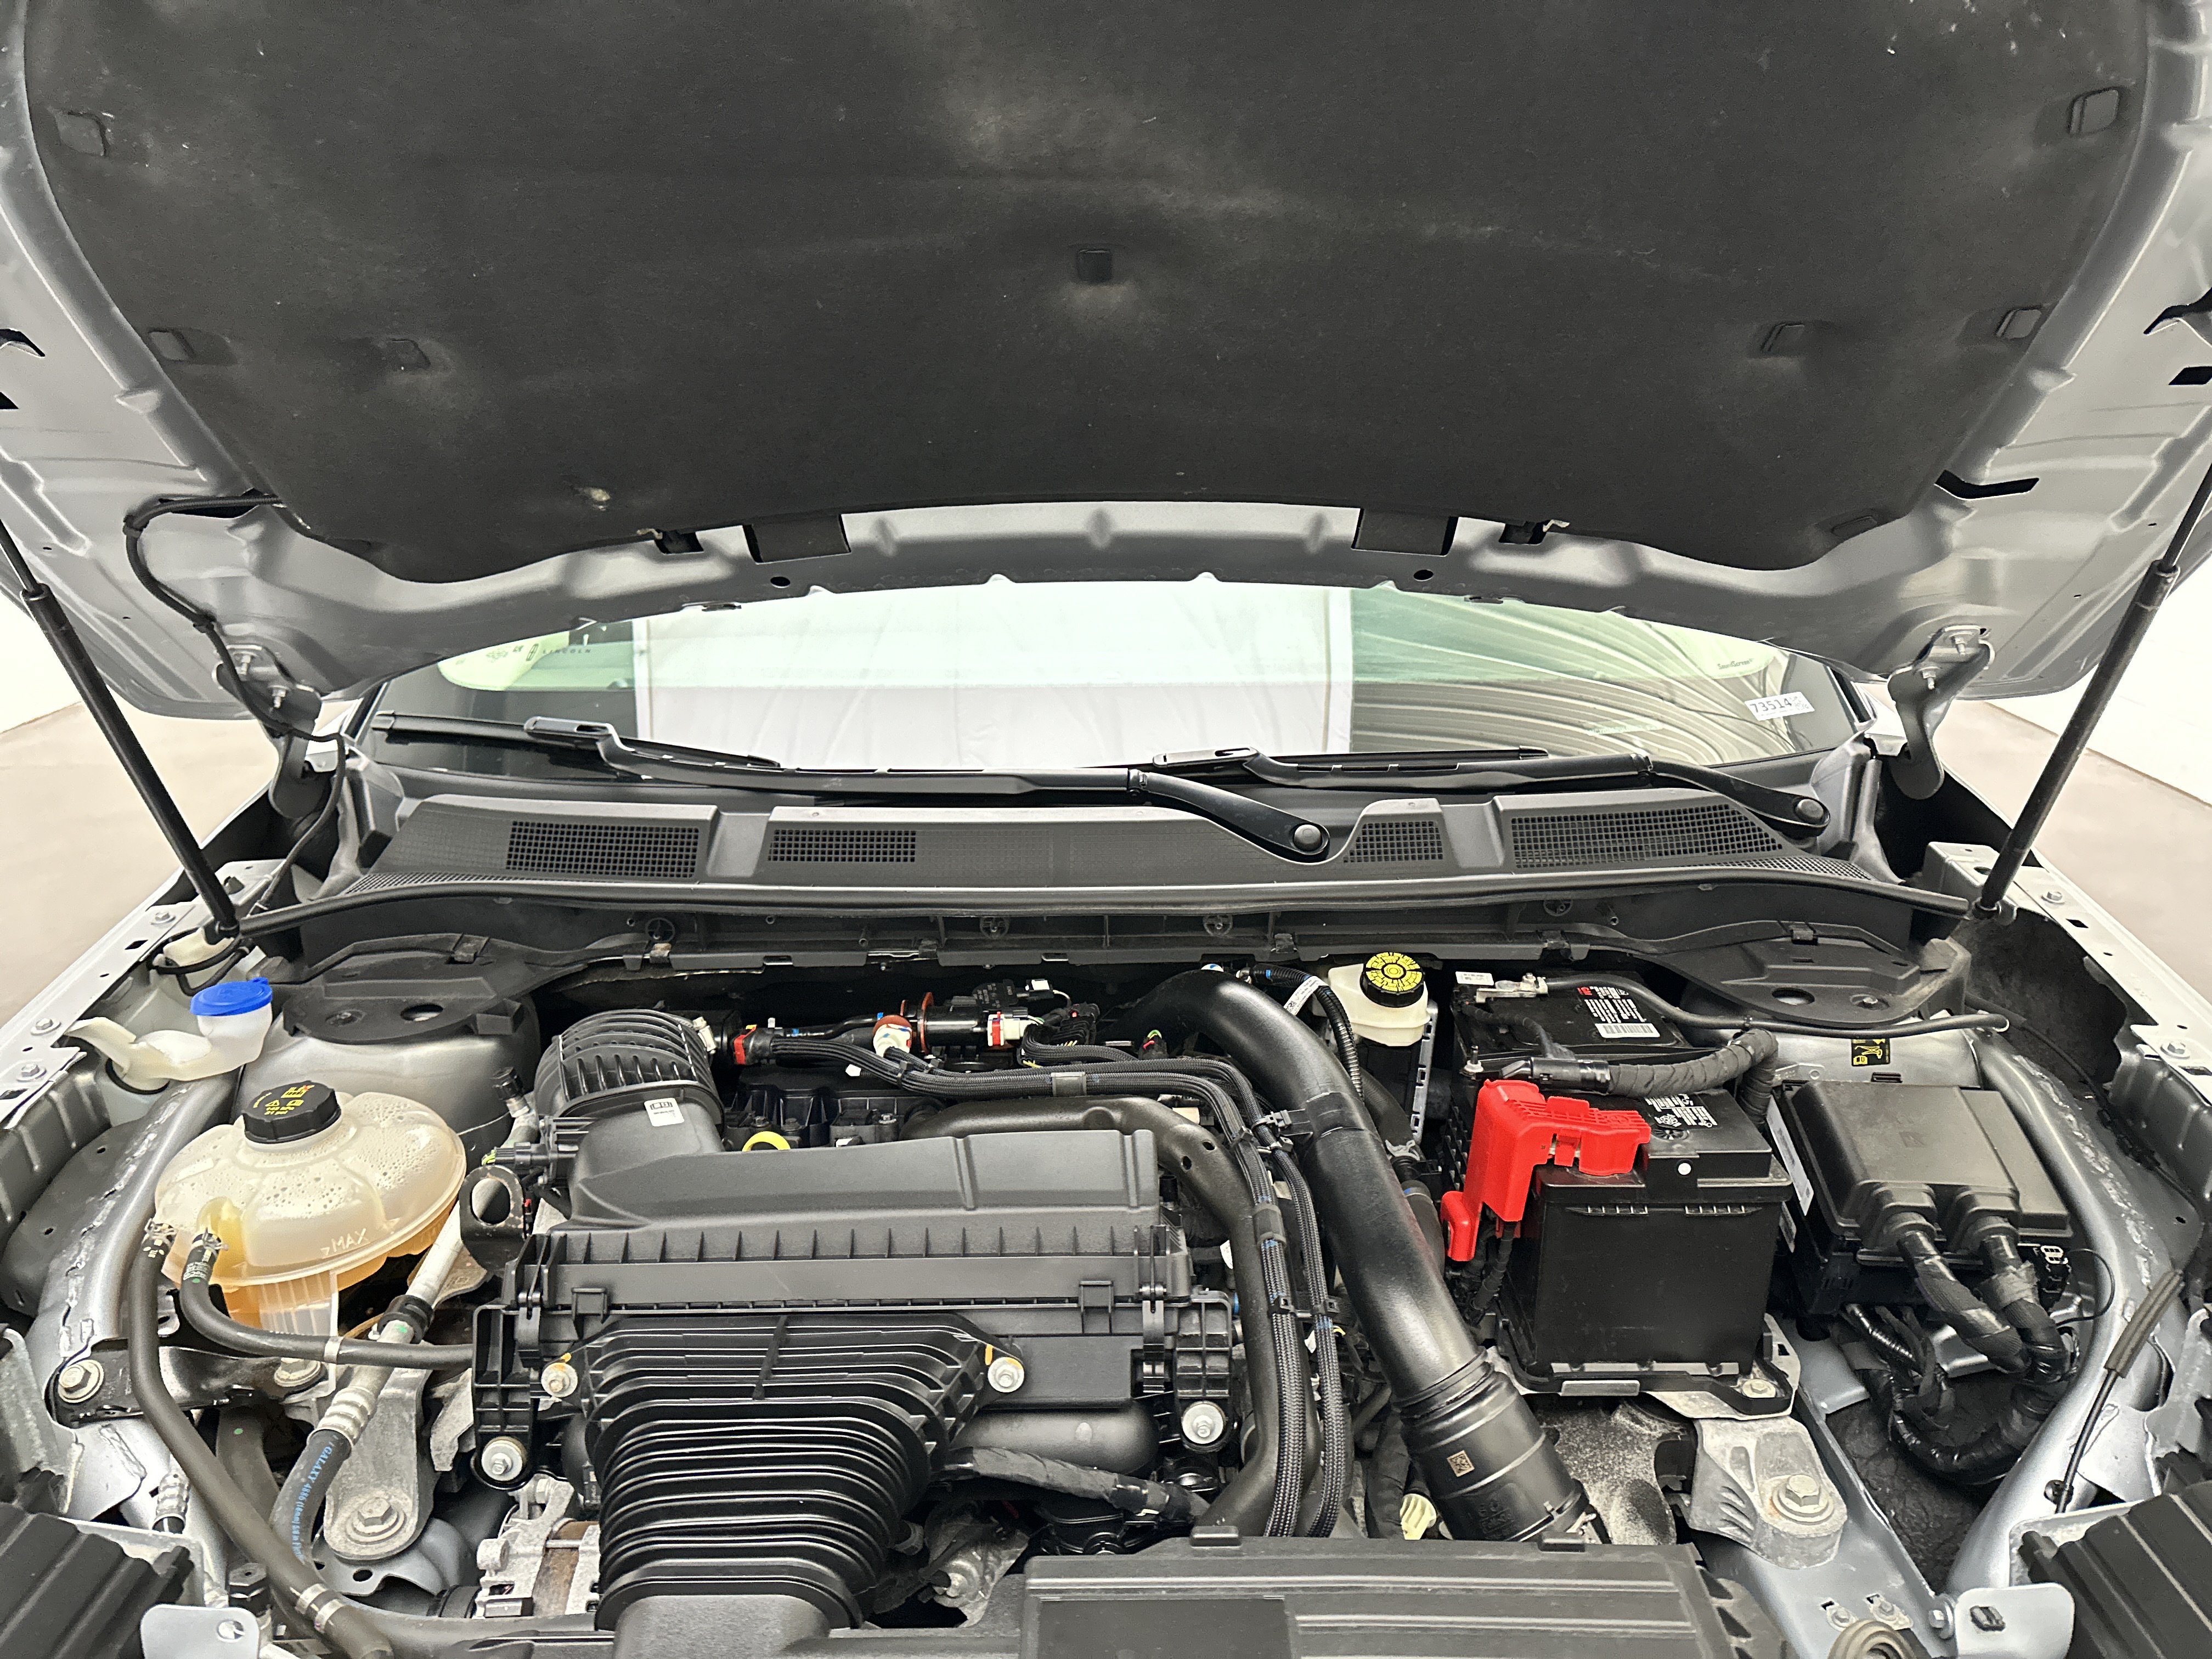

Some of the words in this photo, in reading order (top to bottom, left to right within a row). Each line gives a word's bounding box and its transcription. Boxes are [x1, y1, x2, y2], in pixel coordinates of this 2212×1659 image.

[1717, 660, 1751, 670] SoundScreen
[1750, 698, 1792, 713] 73514
[331, 1228, 369, 1252] MAX
[308, 1446, 332, 1483] GALAXY
[298, 1483, 312, 1502] 4886
